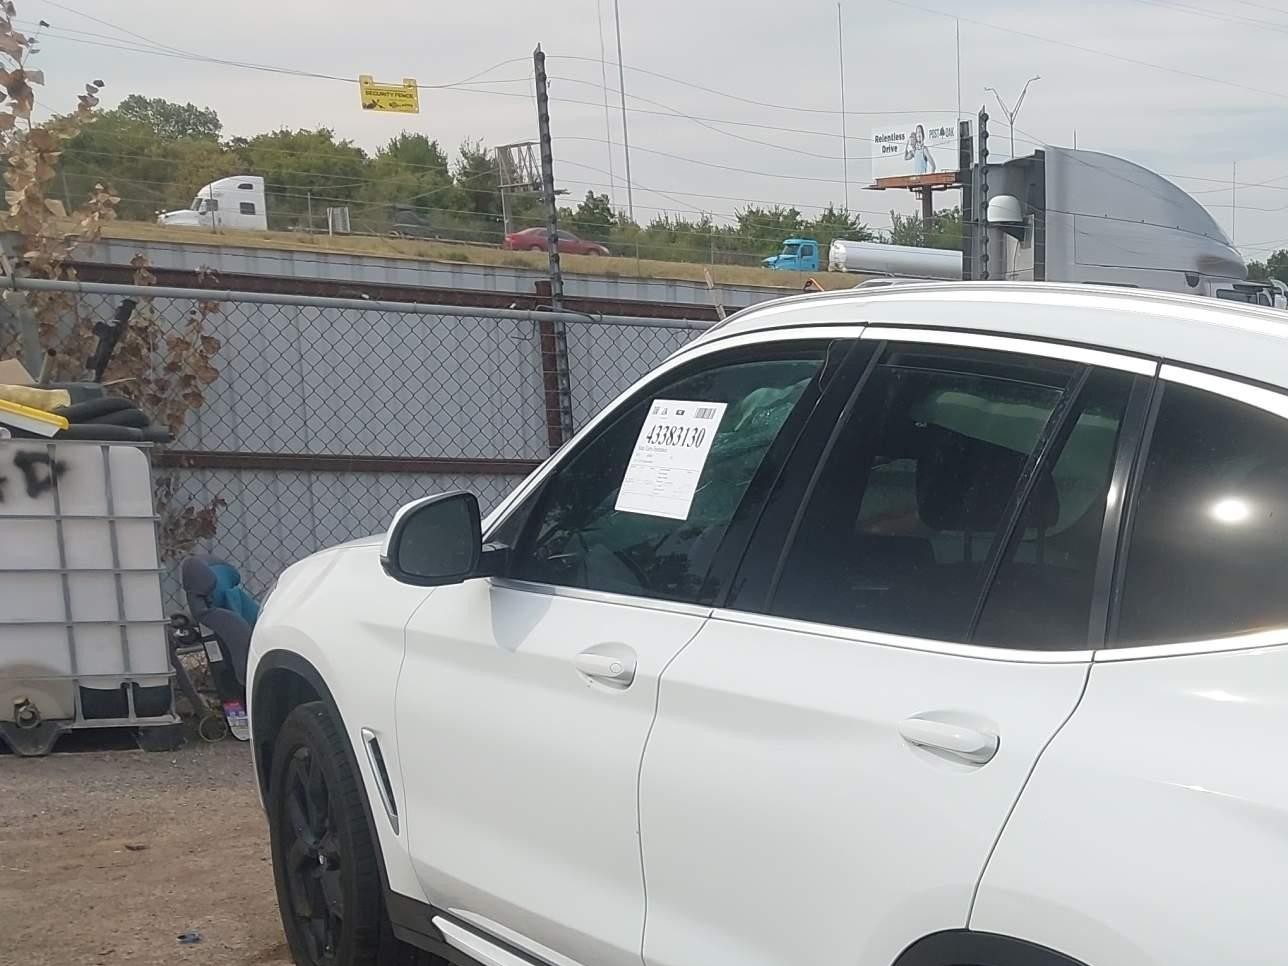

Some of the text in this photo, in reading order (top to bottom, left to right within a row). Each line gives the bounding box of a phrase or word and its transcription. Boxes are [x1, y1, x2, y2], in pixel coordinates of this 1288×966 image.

[875, 132, 905, 143] Relentless
[882, 145, 898, 153] Drive
[646, 424, 706, 448] 43383130
